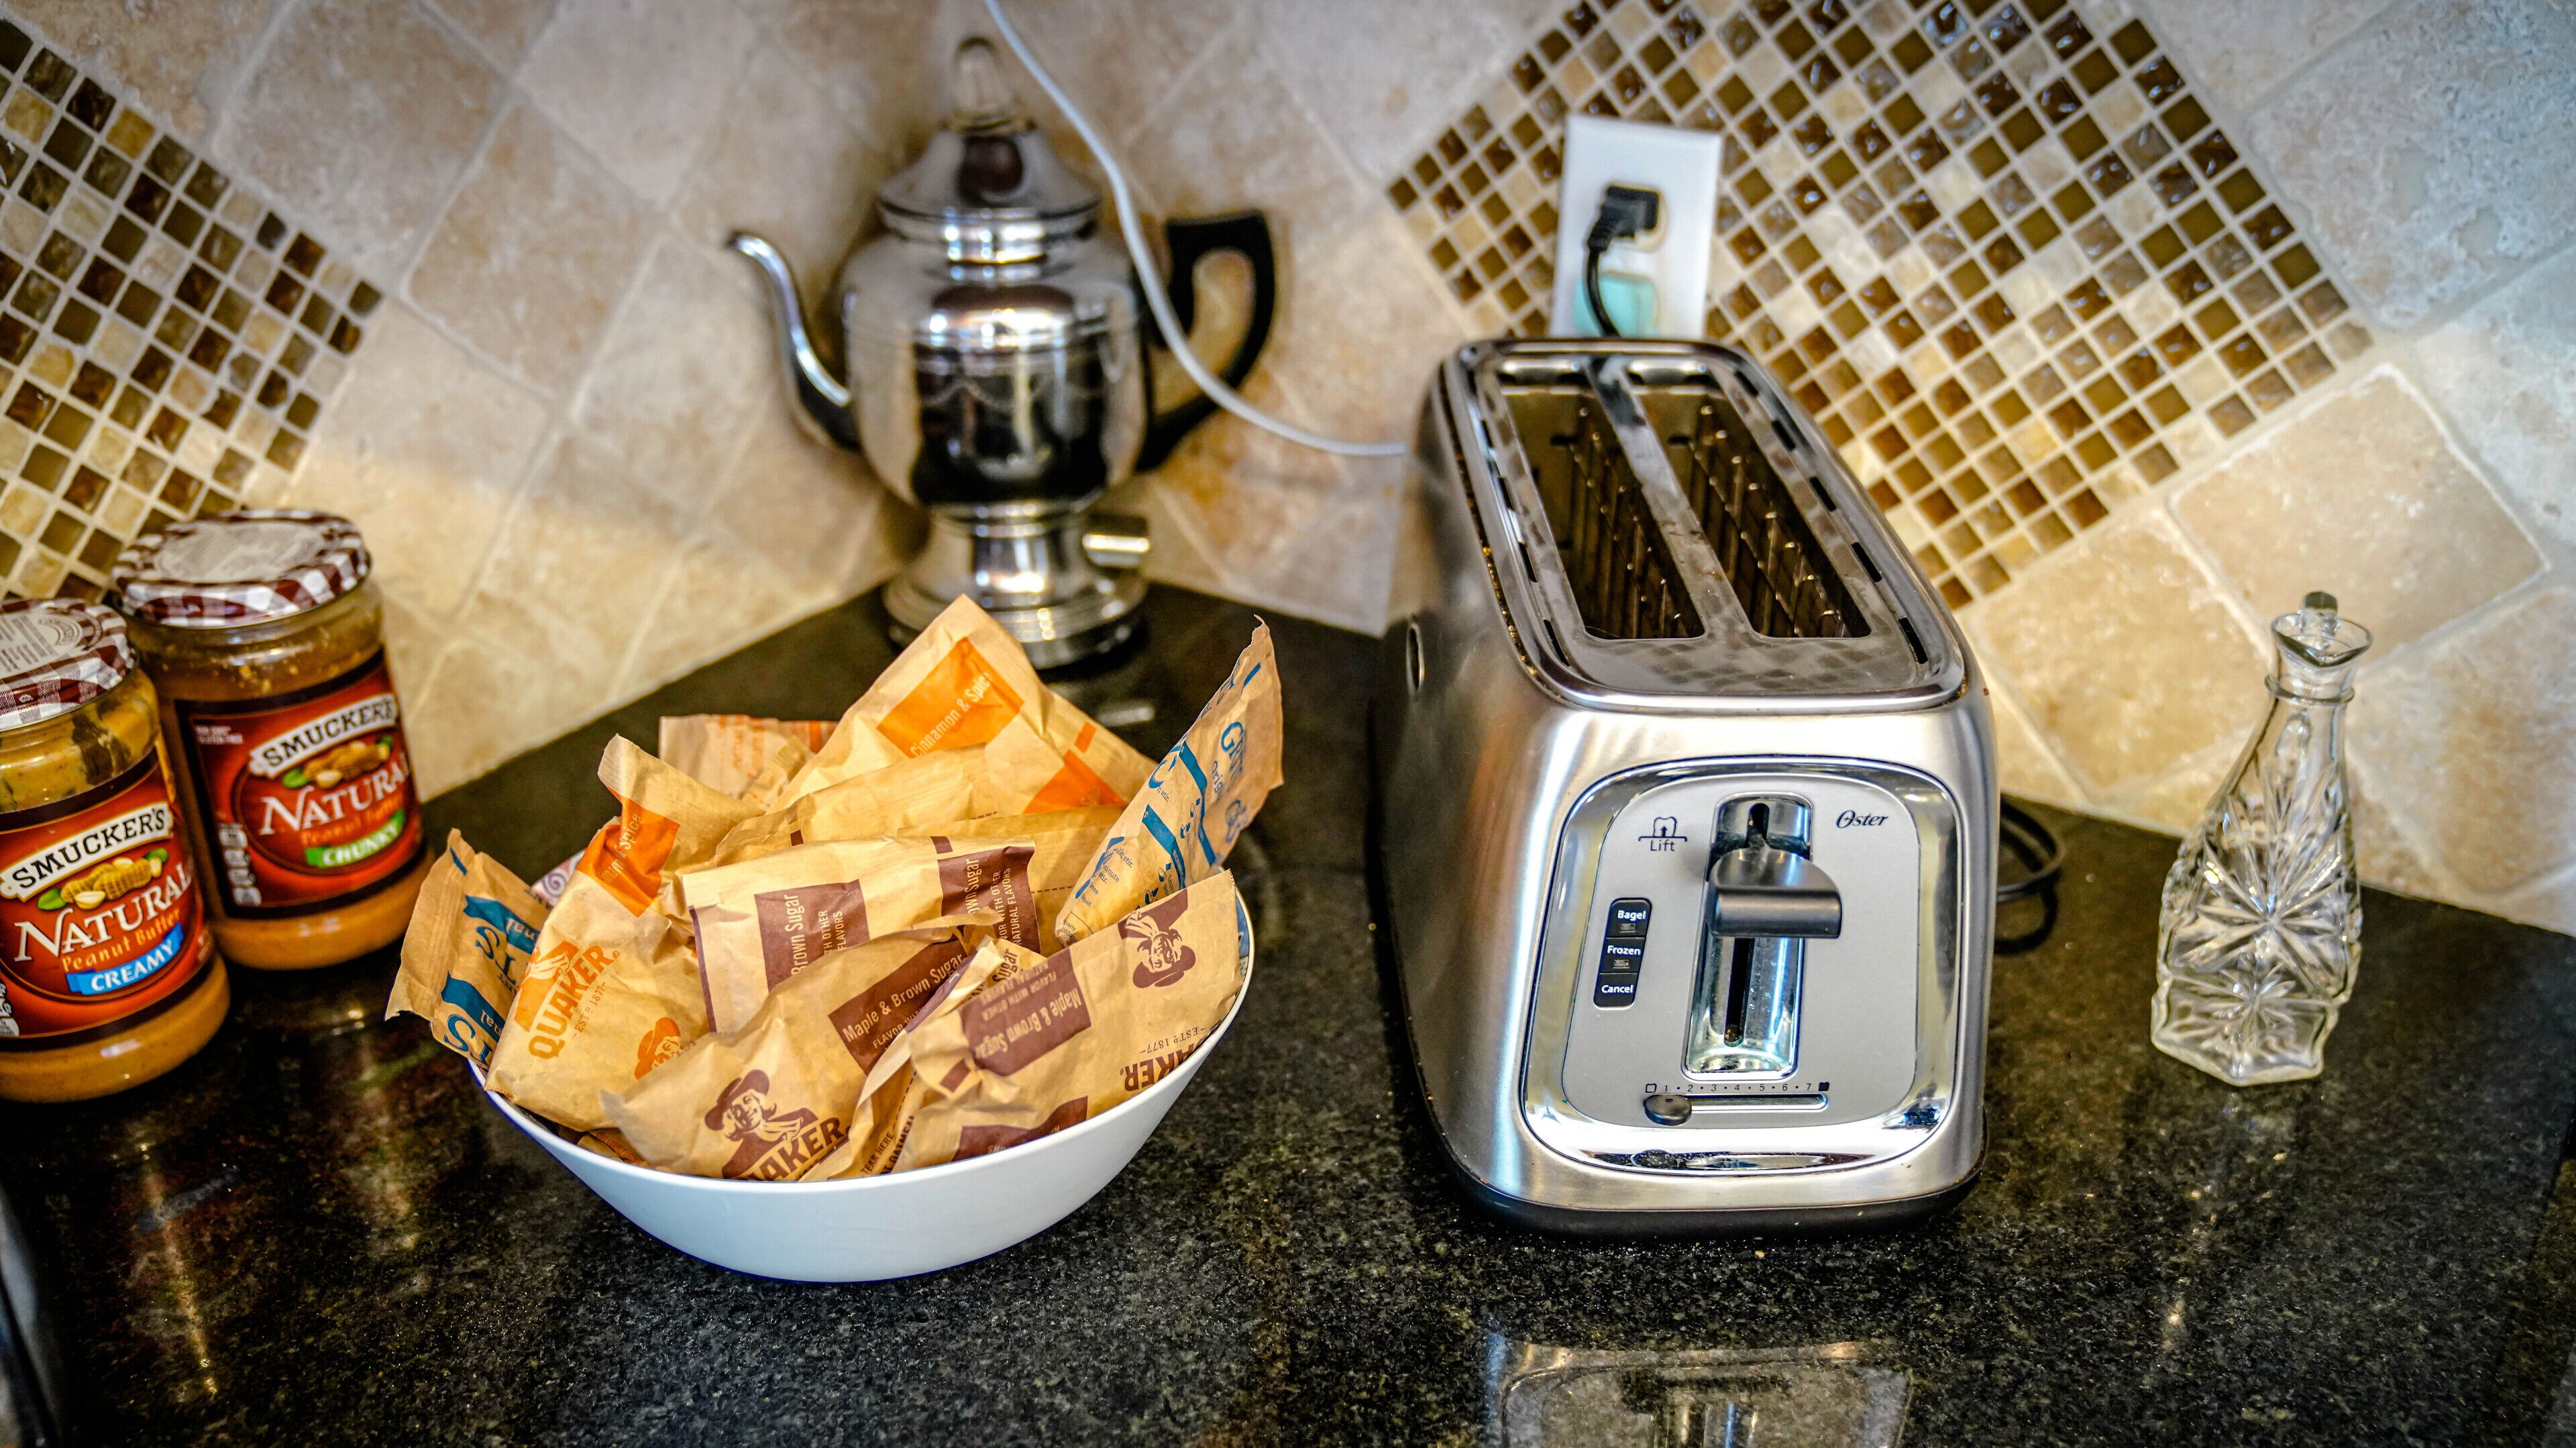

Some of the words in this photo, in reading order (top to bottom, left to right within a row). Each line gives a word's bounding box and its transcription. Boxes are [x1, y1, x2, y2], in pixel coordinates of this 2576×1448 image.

[910, 709, 961, 758] Cinnamon
[956, 698, 971, 712] &
[1835, 810, 1889, 829] Oster
[12, 807, 166, 889] SMUCKER'S
[322, 820, 398, 867] CHUNKY
[1650, 839, 1676, 852] Lift
[964, 858, 983, 893] Sugar
[1002, 868, 1016, 905] FLAVORS
[14, 862, 192, 962] NATURAL
[784, 894, 805, 932] Sugar
[818, 909, 832, 940] OTHER
[1008, 906, 1022, 946] NATURAL
[1617, 909, 1647, 922] Bagel
[61, 937, 131, 973] Peanut
[136, 907, 180, 944] Butter
[833, 910, 847, 951] FLAVORS
[91, 938, 174, 992] CREAMY
[991, 948, 1018, 983] Sugar
[1607, 945, 1642, 956] Frozen
[842, 1012, 881, 1043] Maple
[879, 1001, 892, 1016] &
[890, 977, 931, 1008] Brown
[929, 953, 964, 984] Sugar
[1049, 987, 1082, 1018] Maple
[1601, 984, 1634, 994] Cancel
[1006, 1011, 1042, 1043] Brown
[1039, 1006, 1052, 1026] &
[872, 1022, 905, 1049] FLAVOR
[1734, 1084, 1741, 1092] 4
[1759, 1084, 1766, 1092] 5
[1782, 1083, 1788, 1092] 6
[1806, 1082, 1812, 1092] 7
[860, 1154, 879, 1174] TEAR
[877, 1131, 894, 1157] HERE
